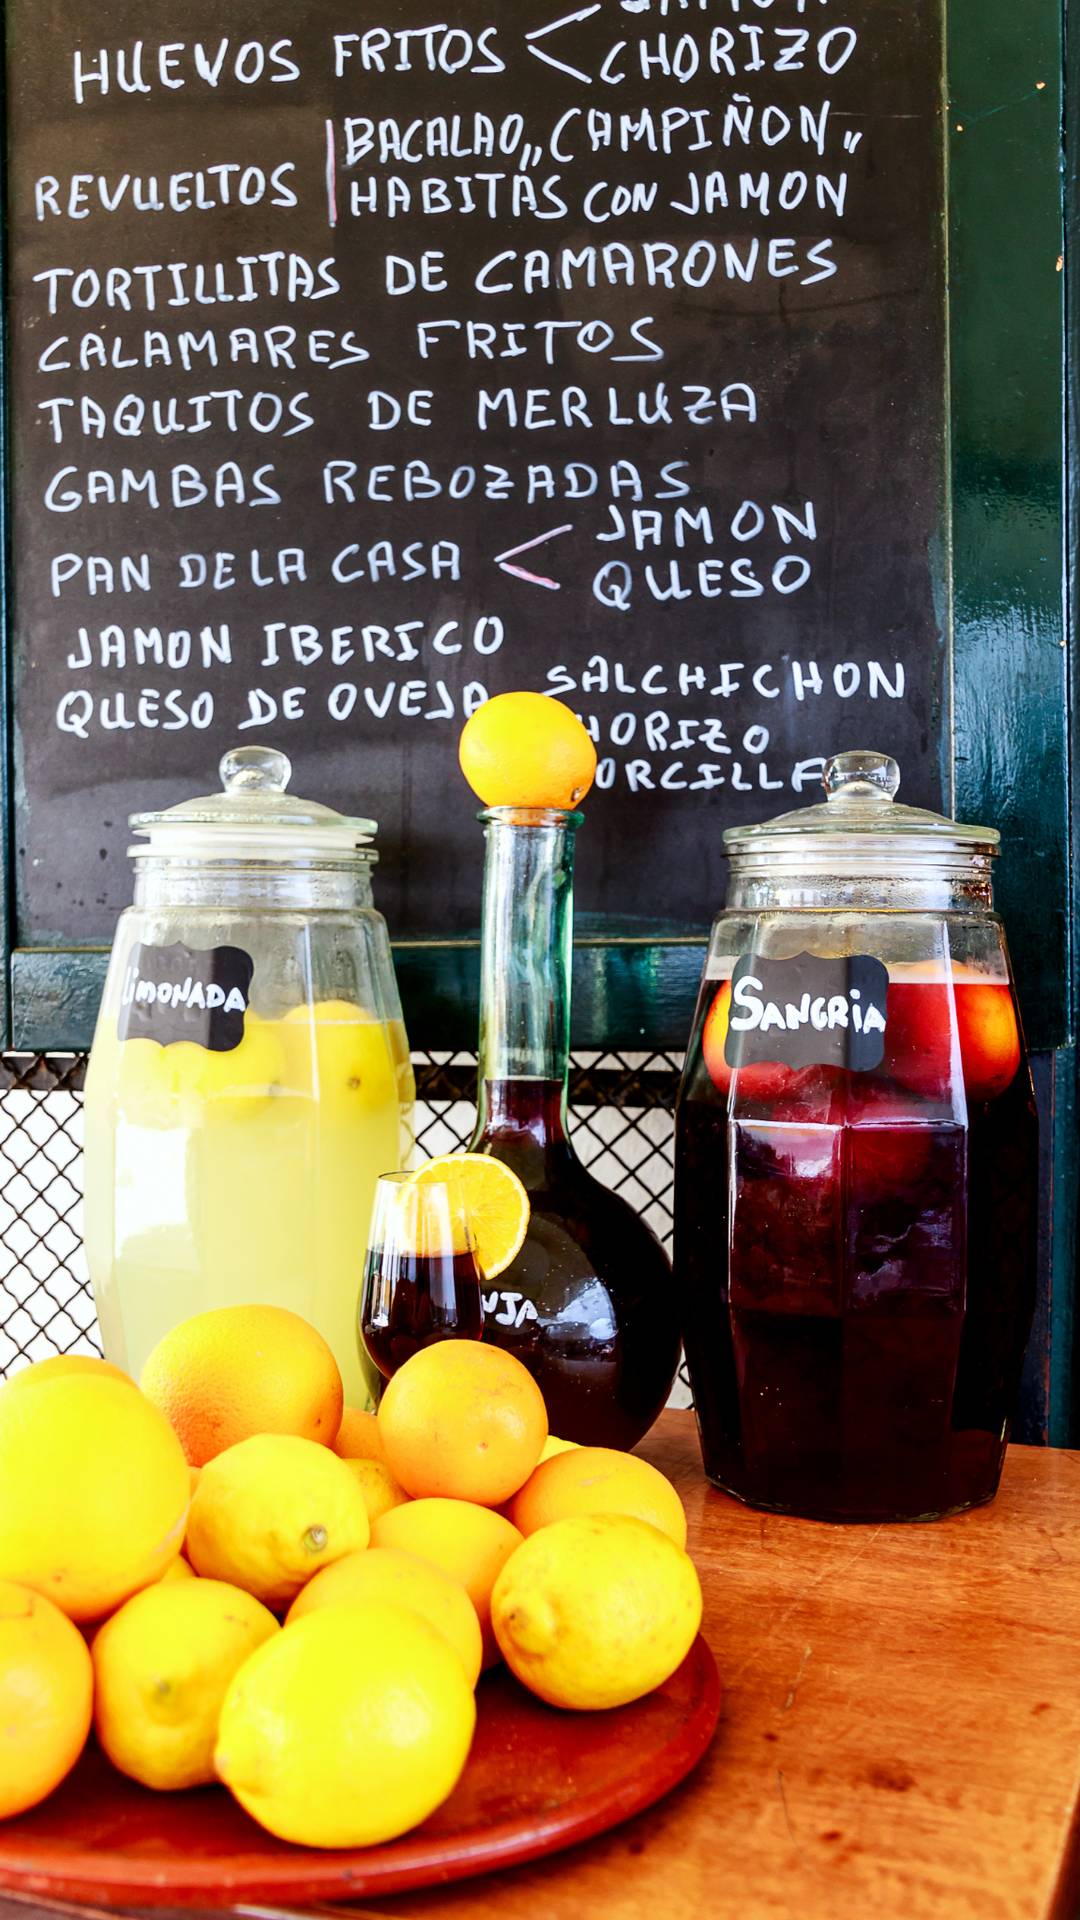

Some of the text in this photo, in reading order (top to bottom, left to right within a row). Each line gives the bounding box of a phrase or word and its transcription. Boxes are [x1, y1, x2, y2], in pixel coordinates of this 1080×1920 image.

[73, 23, 506, 105] HUEVOS FRITOS
[599, 23, 857, 85] CHORIZO
[34, 161, 298, 222] REVUELTOS
[350, 170, 847, 223] HABITAS CON JAMON
[32, 237, 837, 315] TORTILLITAS DE CAMARONES
[38, 316, 664, 372] CALAMARES FRITOS
[37, 382, 757, 444] TAQUITOS DE MERLUZA
[44, 459, 690, 513] GAMBAS REBOZADAS
[596, 500, 817, 551] JAMON
[50, 540, 460, 598] PAN DE LA CASA
[592, 555, 811, 611] QUESO
[66, 616, 504, 670] JAMON IBERICO
[541, 655, 905, 701] SALCHICHON
[55, 680, 489, 739] QUESO DE OVEJA
[576, 710, 770, 755] HORIZO
[595, 757, 828, 792] ORCILLA
